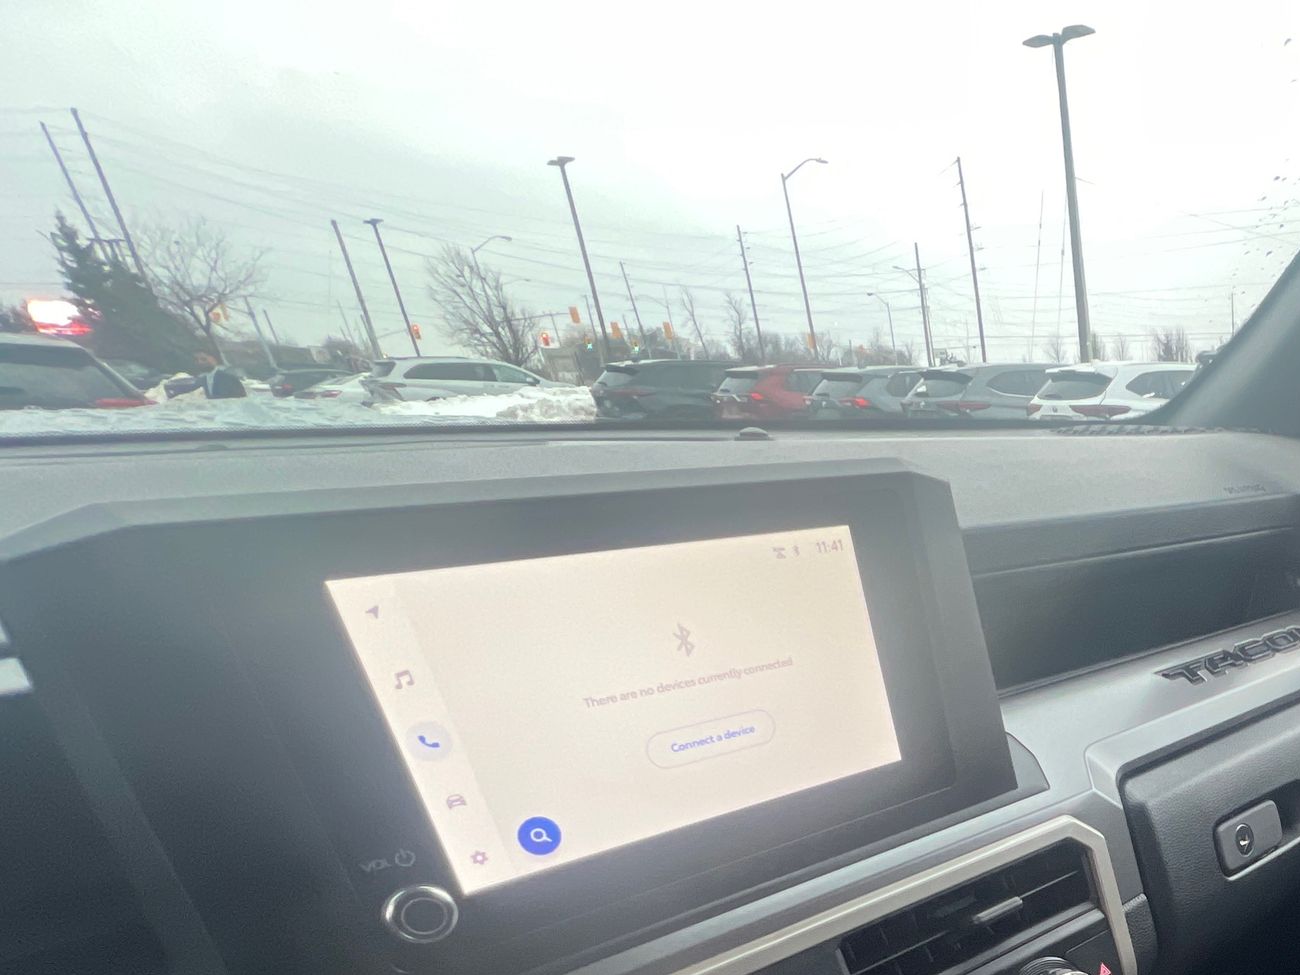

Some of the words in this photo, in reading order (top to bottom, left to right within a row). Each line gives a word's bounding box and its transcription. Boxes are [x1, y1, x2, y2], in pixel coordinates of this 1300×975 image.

[816, 538, 844, 553] 11:41
[583, 692, 618, 709] There
[619, 690, 638, 701] are
[639, 686, 655, 698] no
[656, 678, 696, 694] devices
[697, 667, 743, 685] currently
[743, 656, 793, 676] connected
[670, 734, 716, 753] Connect
[715, 733, 724, 742] a
[723, 724, 756, 741] device
[359, 858, 392, 873] VOL
